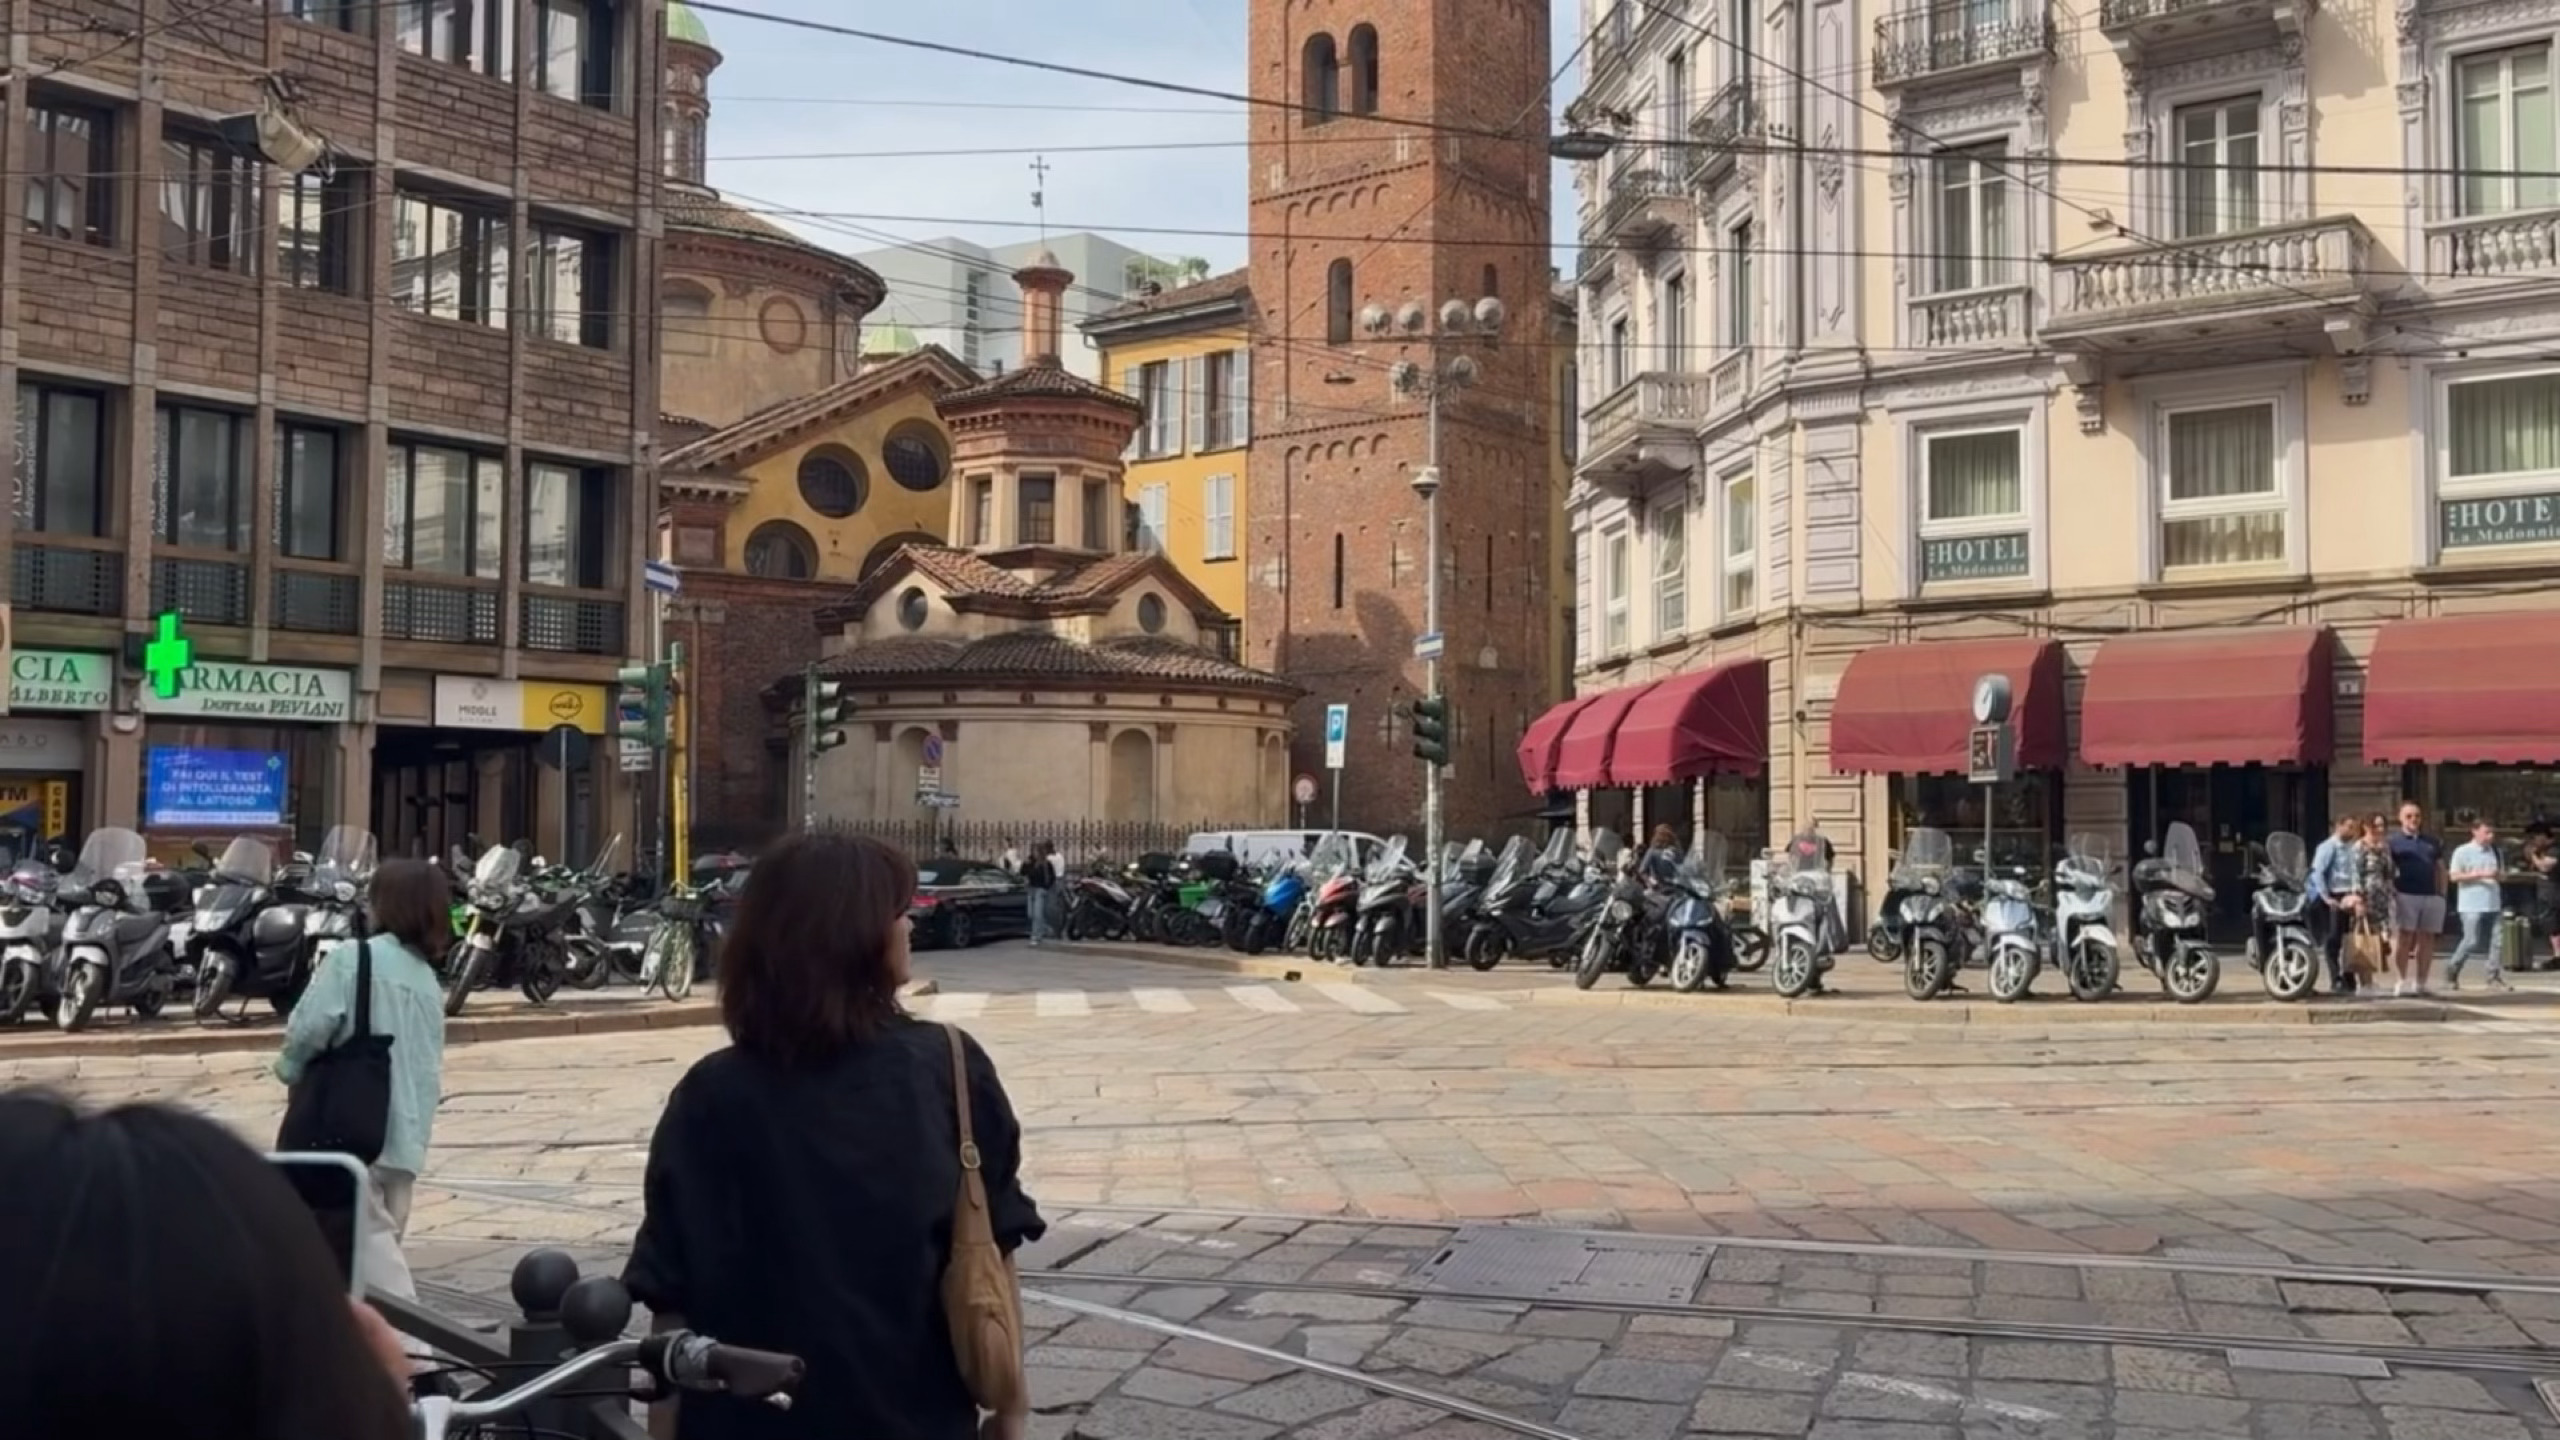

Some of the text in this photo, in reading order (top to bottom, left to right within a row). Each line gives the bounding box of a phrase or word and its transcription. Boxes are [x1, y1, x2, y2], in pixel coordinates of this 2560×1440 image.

[2461, 497, 2560, 528] HOTE
[2448, 531, 2469, 544] La
[1938, 538, 2025, 564] HOTEL
[149, 665, 325, 698] ARMACIA
[233, 770, 264, 781] TEST
